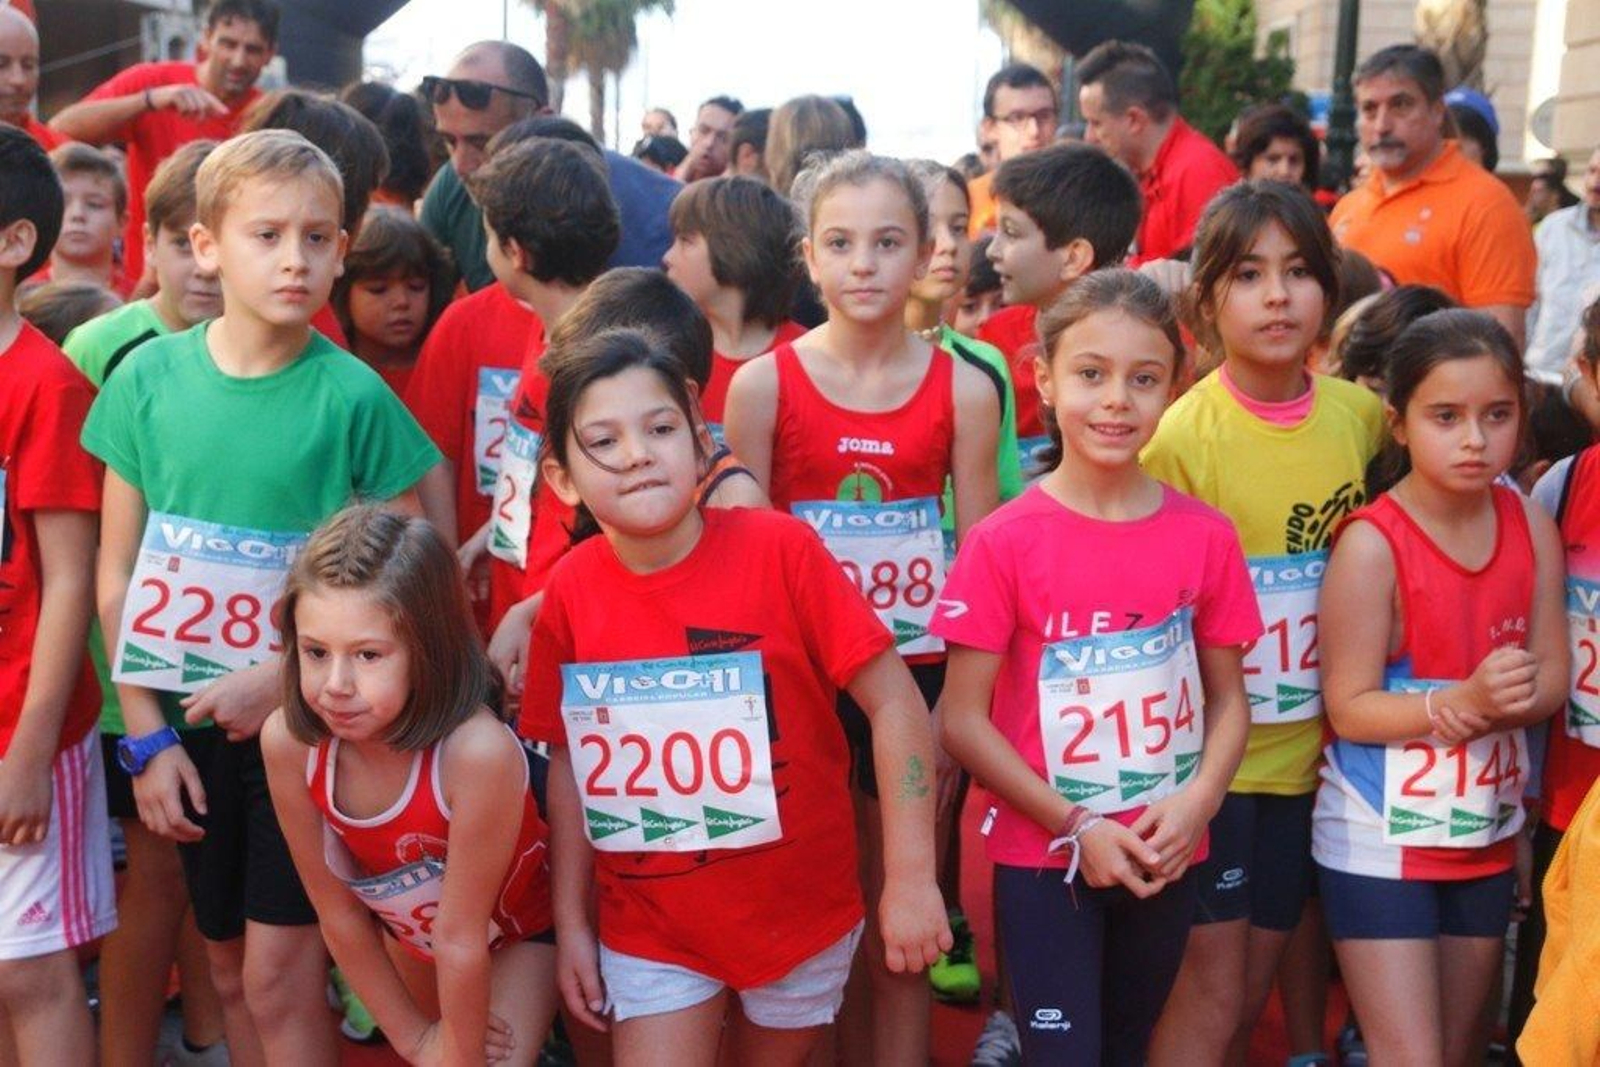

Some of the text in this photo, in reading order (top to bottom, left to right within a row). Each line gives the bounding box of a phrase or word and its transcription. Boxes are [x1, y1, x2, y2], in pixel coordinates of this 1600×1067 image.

[1058, 677, 1195, 765] 2154
[580, 728, 752, 796] 2200
[1400, 734, 1521, 798] 2144
